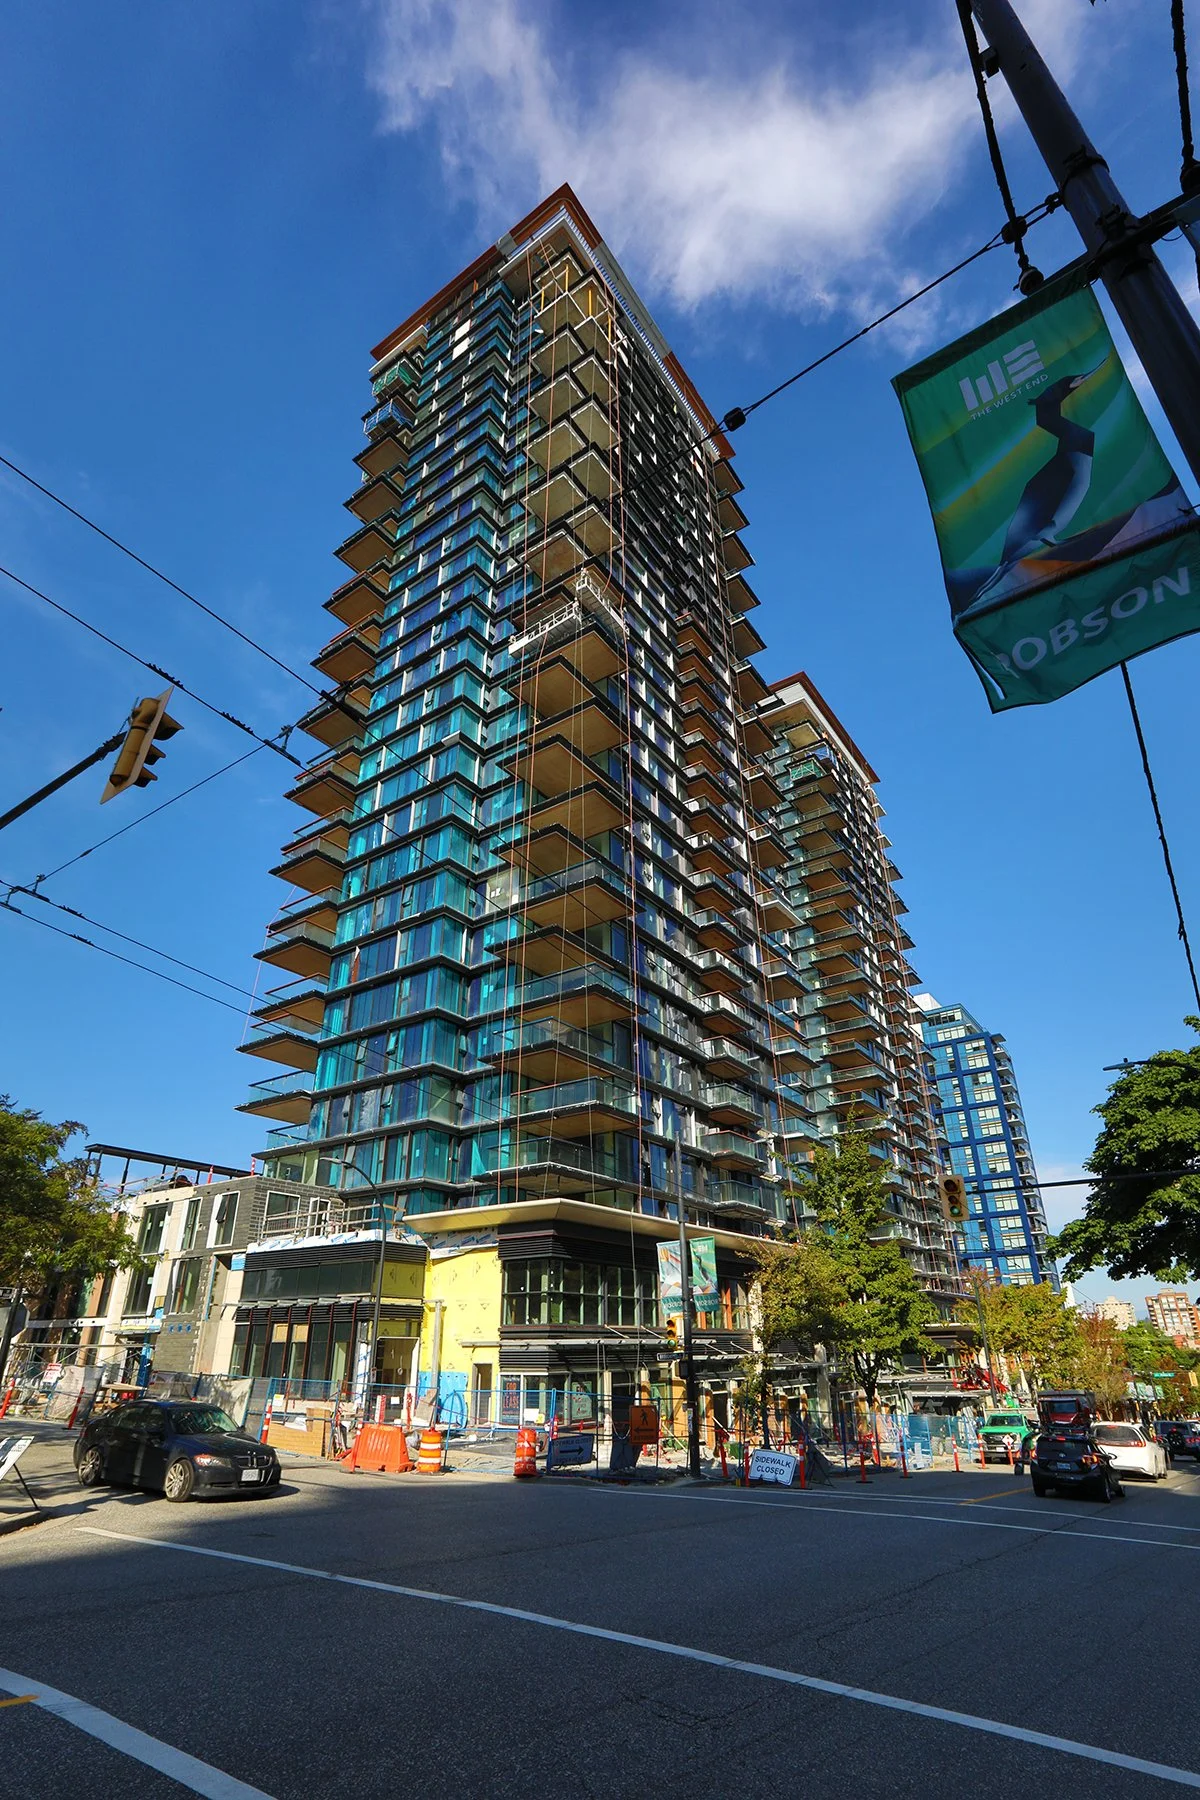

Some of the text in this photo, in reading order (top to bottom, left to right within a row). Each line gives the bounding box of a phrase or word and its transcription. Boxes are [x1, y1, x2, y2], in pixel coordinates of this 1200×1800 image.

[971, 374, 1048, 421] THE WEST END
[755, 1456, 791, 1468] SIDEWALK
[757, 1465, 785, 1476] CLOSED
